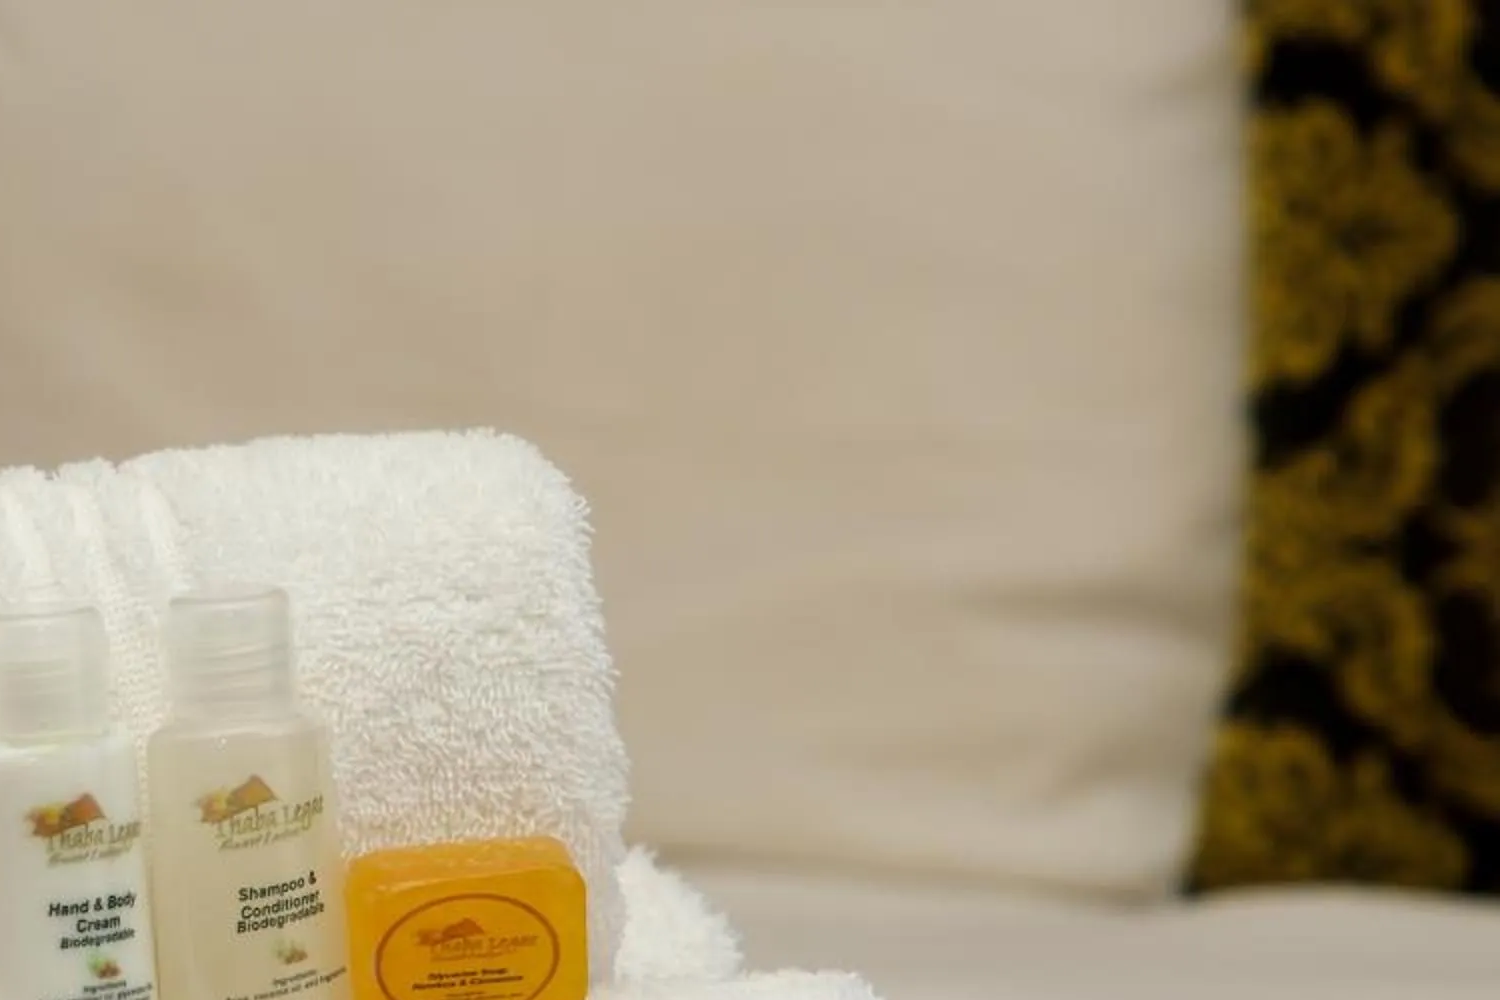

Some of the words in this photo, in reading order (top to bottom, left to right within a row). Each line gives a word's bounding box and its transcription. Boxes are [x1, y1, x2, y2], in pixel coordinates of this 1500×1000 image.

[238, 877, 305, 902] Shampoo
[308, 870, 318, 885] &
[48, 900, 90, 917] Hand
[93, 897, 104, 912] &
[107, 892, 137, 909] Body
[241, 890, 320, 920] Conditioner
[76, 915, 121, 933] Cream
